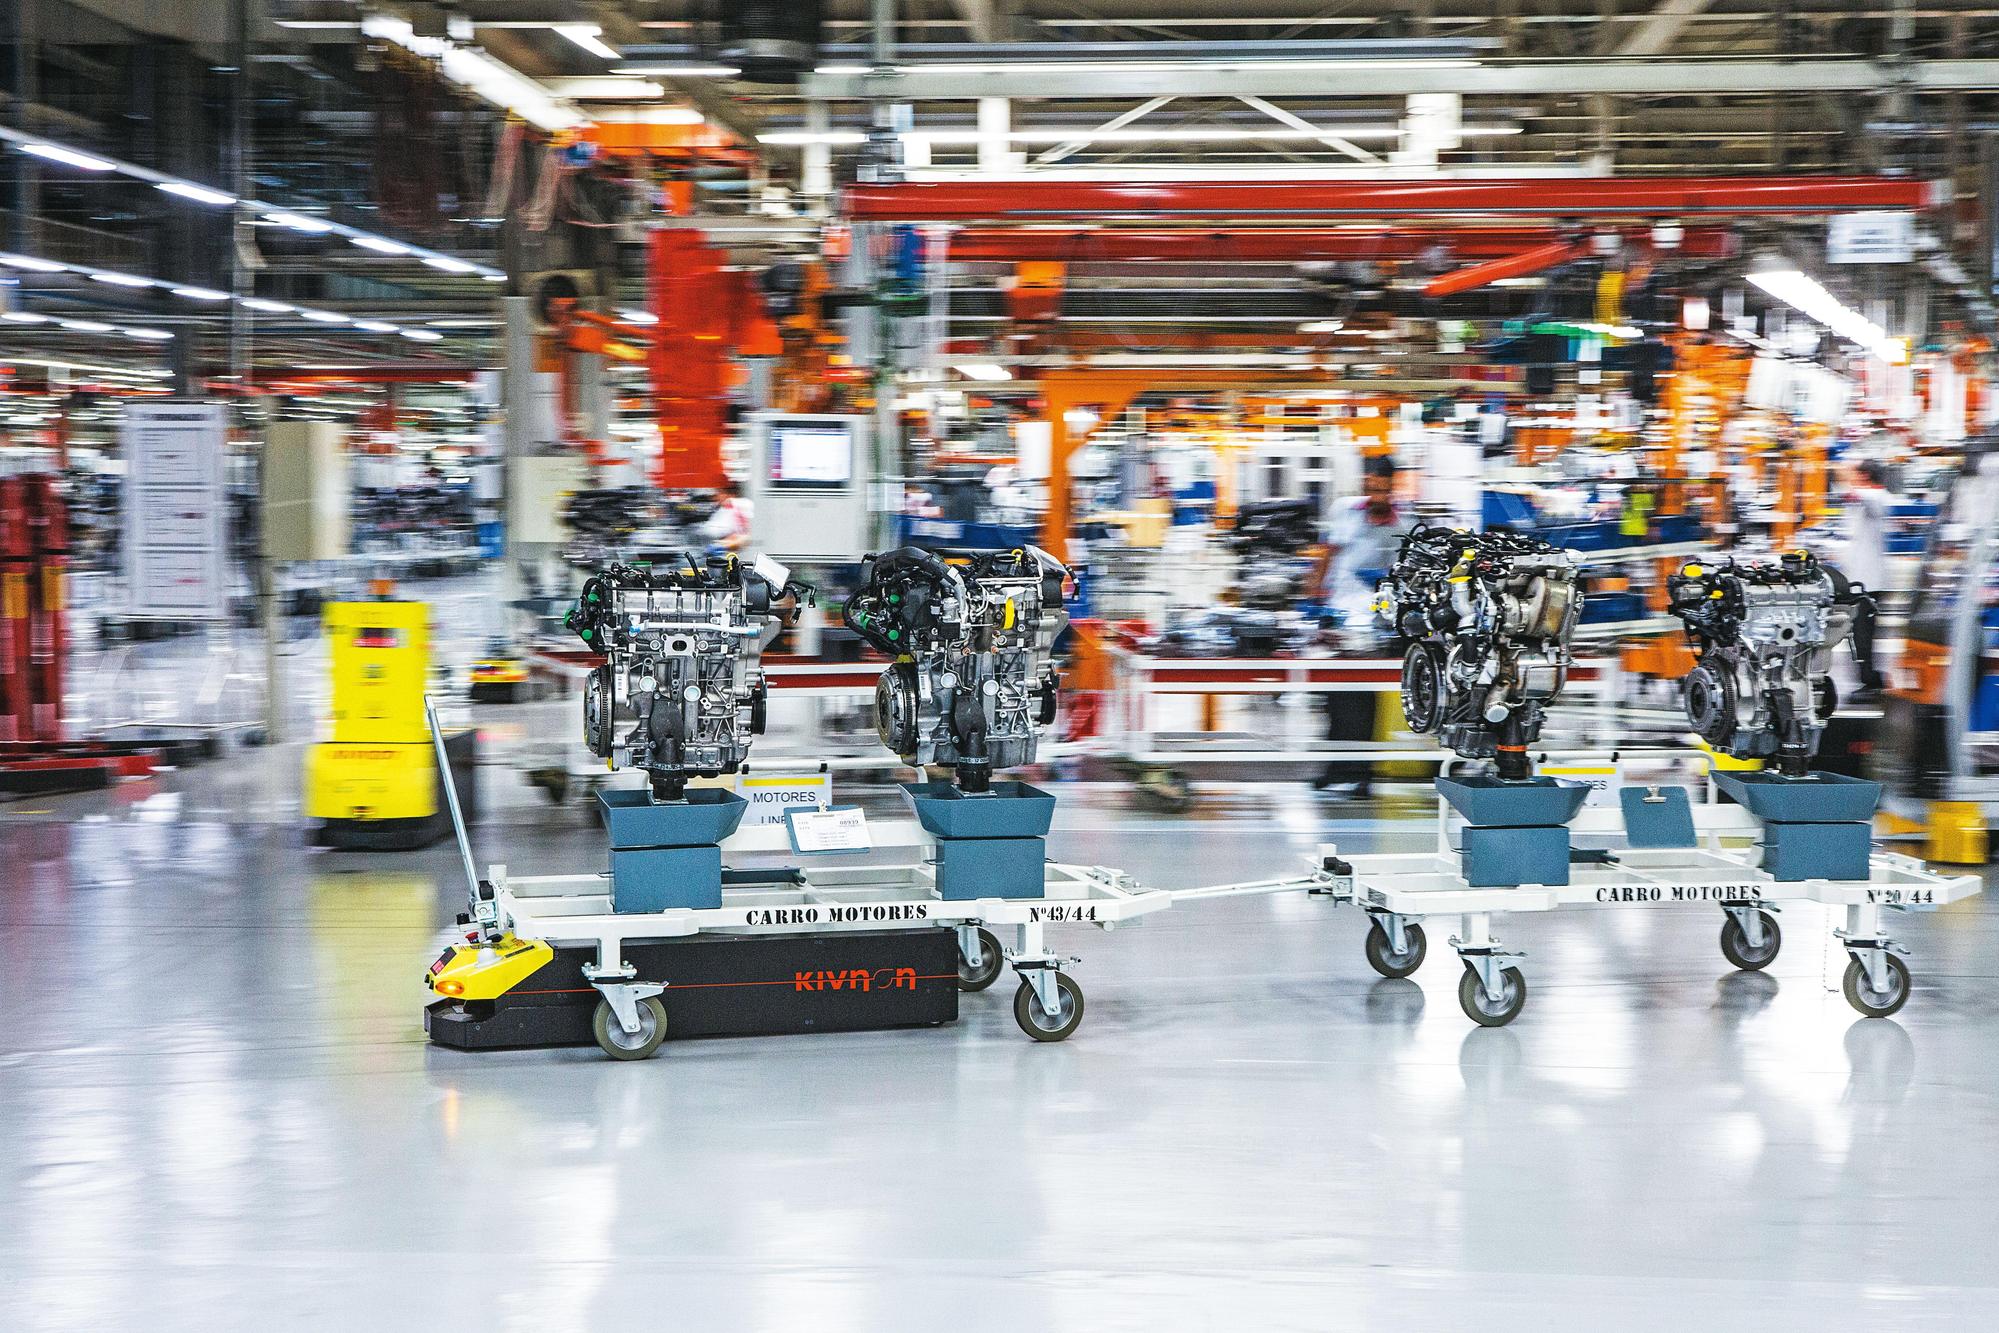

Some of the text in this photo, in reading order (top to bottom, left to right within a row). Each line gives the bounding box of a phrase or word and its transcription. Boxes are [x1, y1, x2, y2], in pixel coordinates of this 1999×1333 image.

[753, 791, 816, 803] MOTORES
[1596, 885, 1762, 902] CARRO MOTORES
[745, 904, 929, 926] CARRO MOTORES
